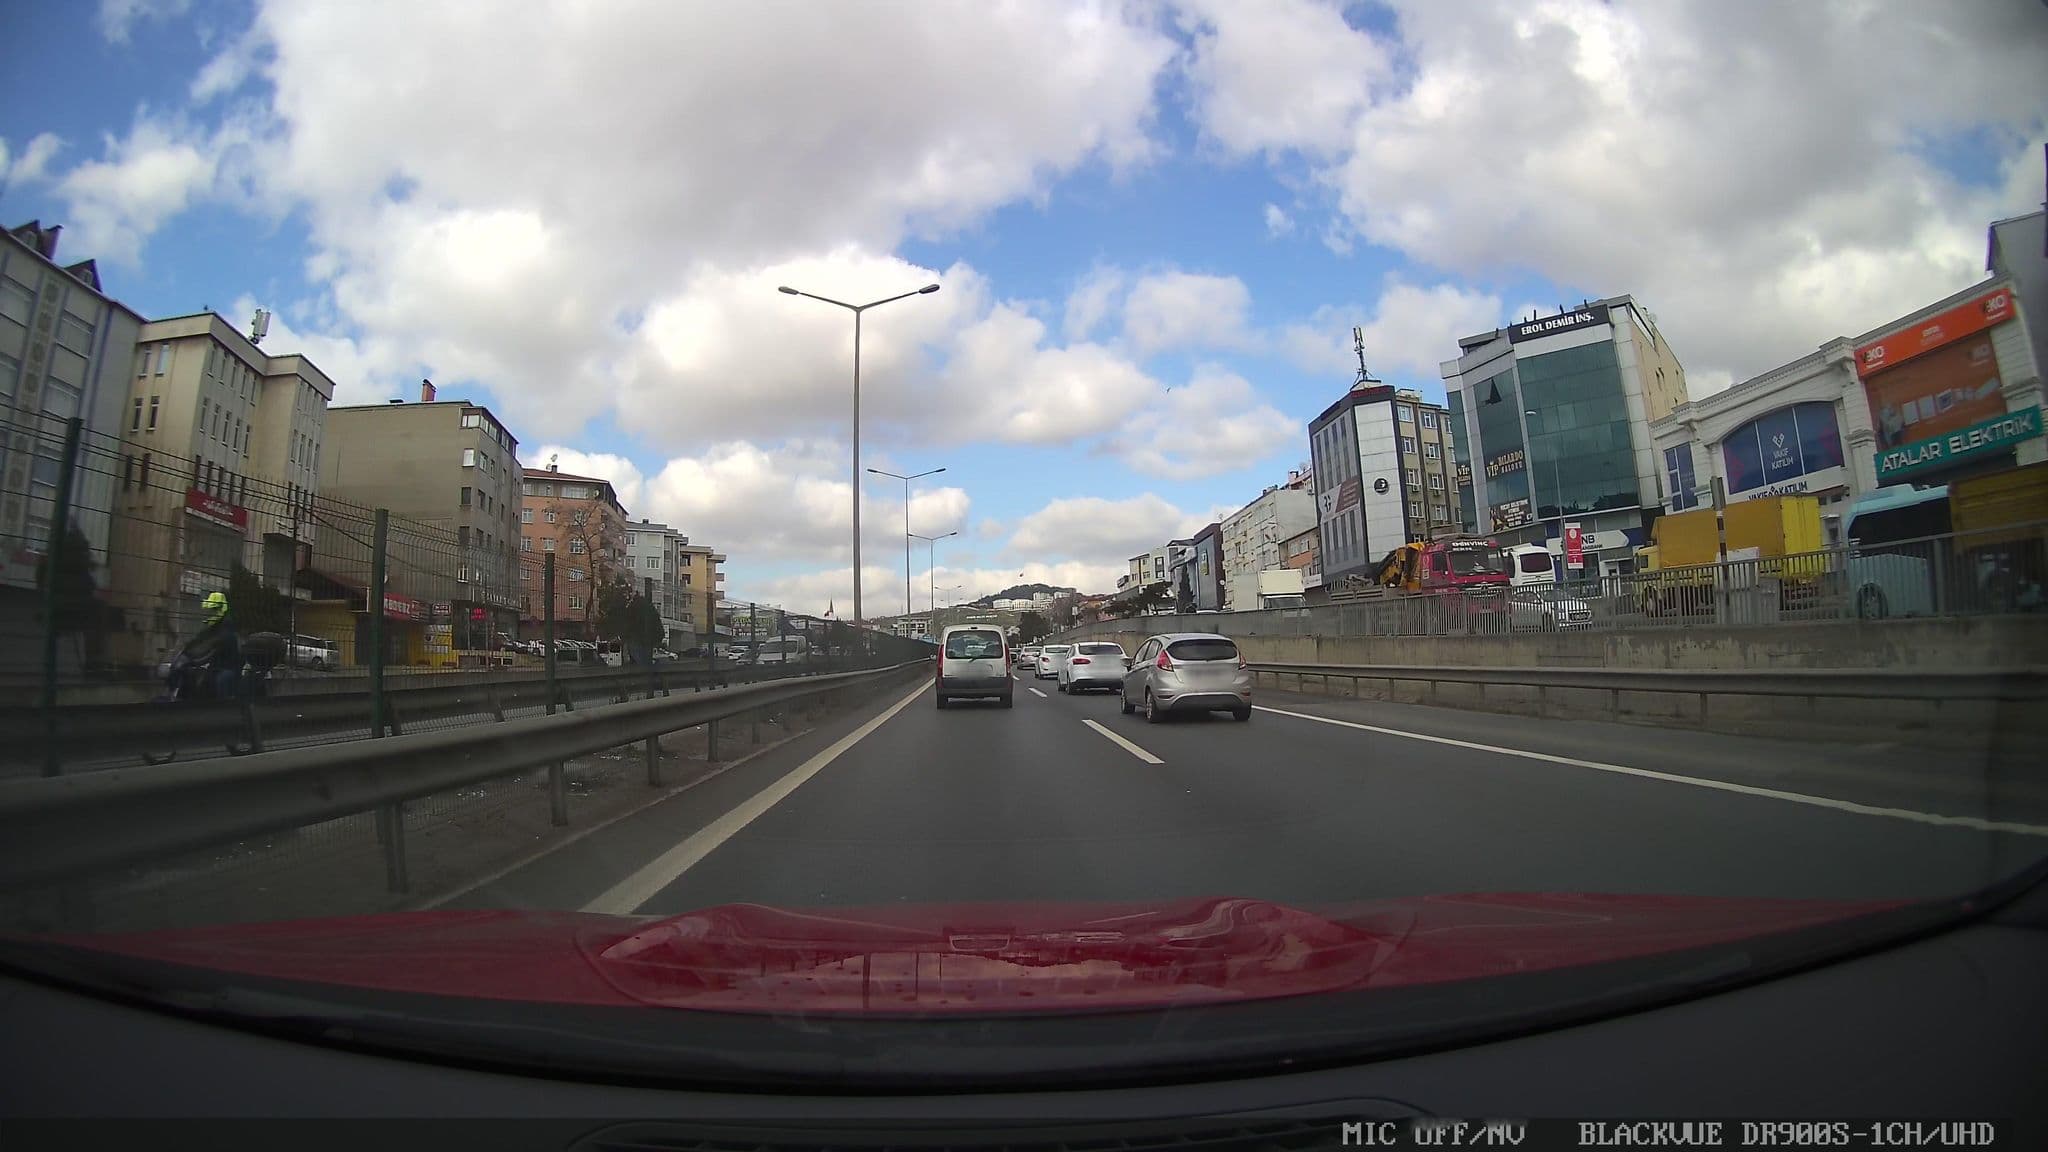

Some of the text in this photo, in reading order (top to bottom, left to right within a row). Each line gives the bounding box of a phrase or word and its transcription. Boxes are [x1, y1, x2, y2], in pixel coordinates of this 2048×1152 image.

[1521, 323, 1544, 335] EROL
[1545, 314, 1575, 330] DEMİR
[1881, 442, 1942, 472] ATALAR
